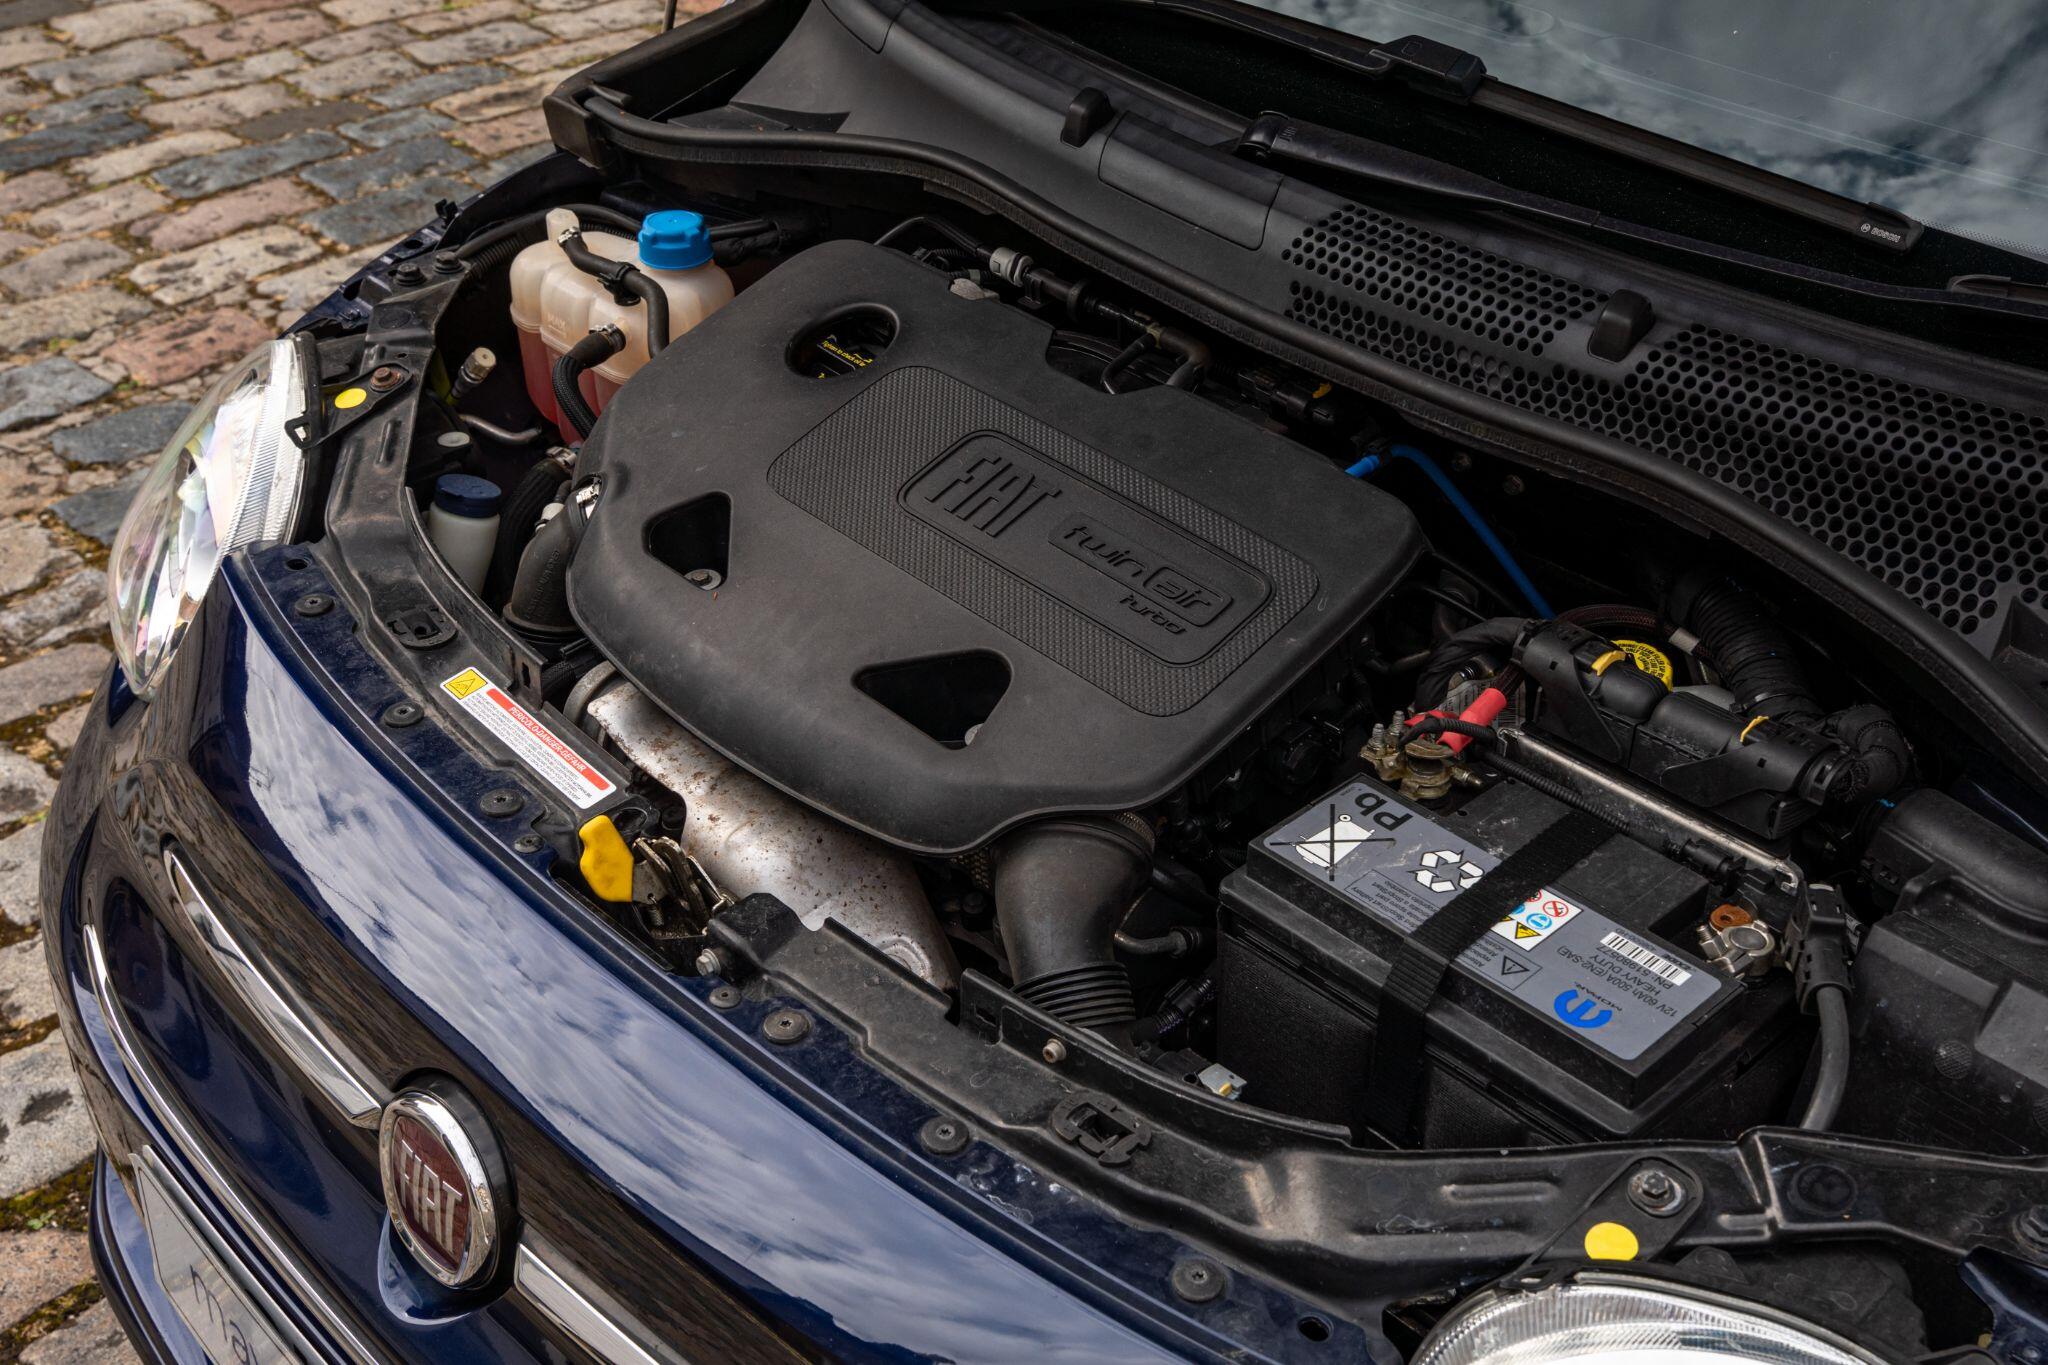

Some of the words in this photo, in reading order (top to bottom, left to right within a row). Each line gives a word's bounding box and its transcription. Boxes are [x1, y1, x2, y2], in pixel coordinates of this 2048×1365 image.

[924, 456, 1064, 539] FIAT
[1119, 592, 1188, 636] turbo
[1355, 793, 1414, 831] Pb
[1589, 954, 1624, 977] DUTY
[1596, 945, 1650, 977] 51980577
[1606, 975, 1633, 992] 500A
[1621, 972, 1661, 996] HEAVY
[1650, 976, 1675, 990] PN:
[1631, 990, 1660, 1007] 60Ah
[1656, 1003, 1679, 1018] 12V
[401, 1139, 463, 1255] FIAT
